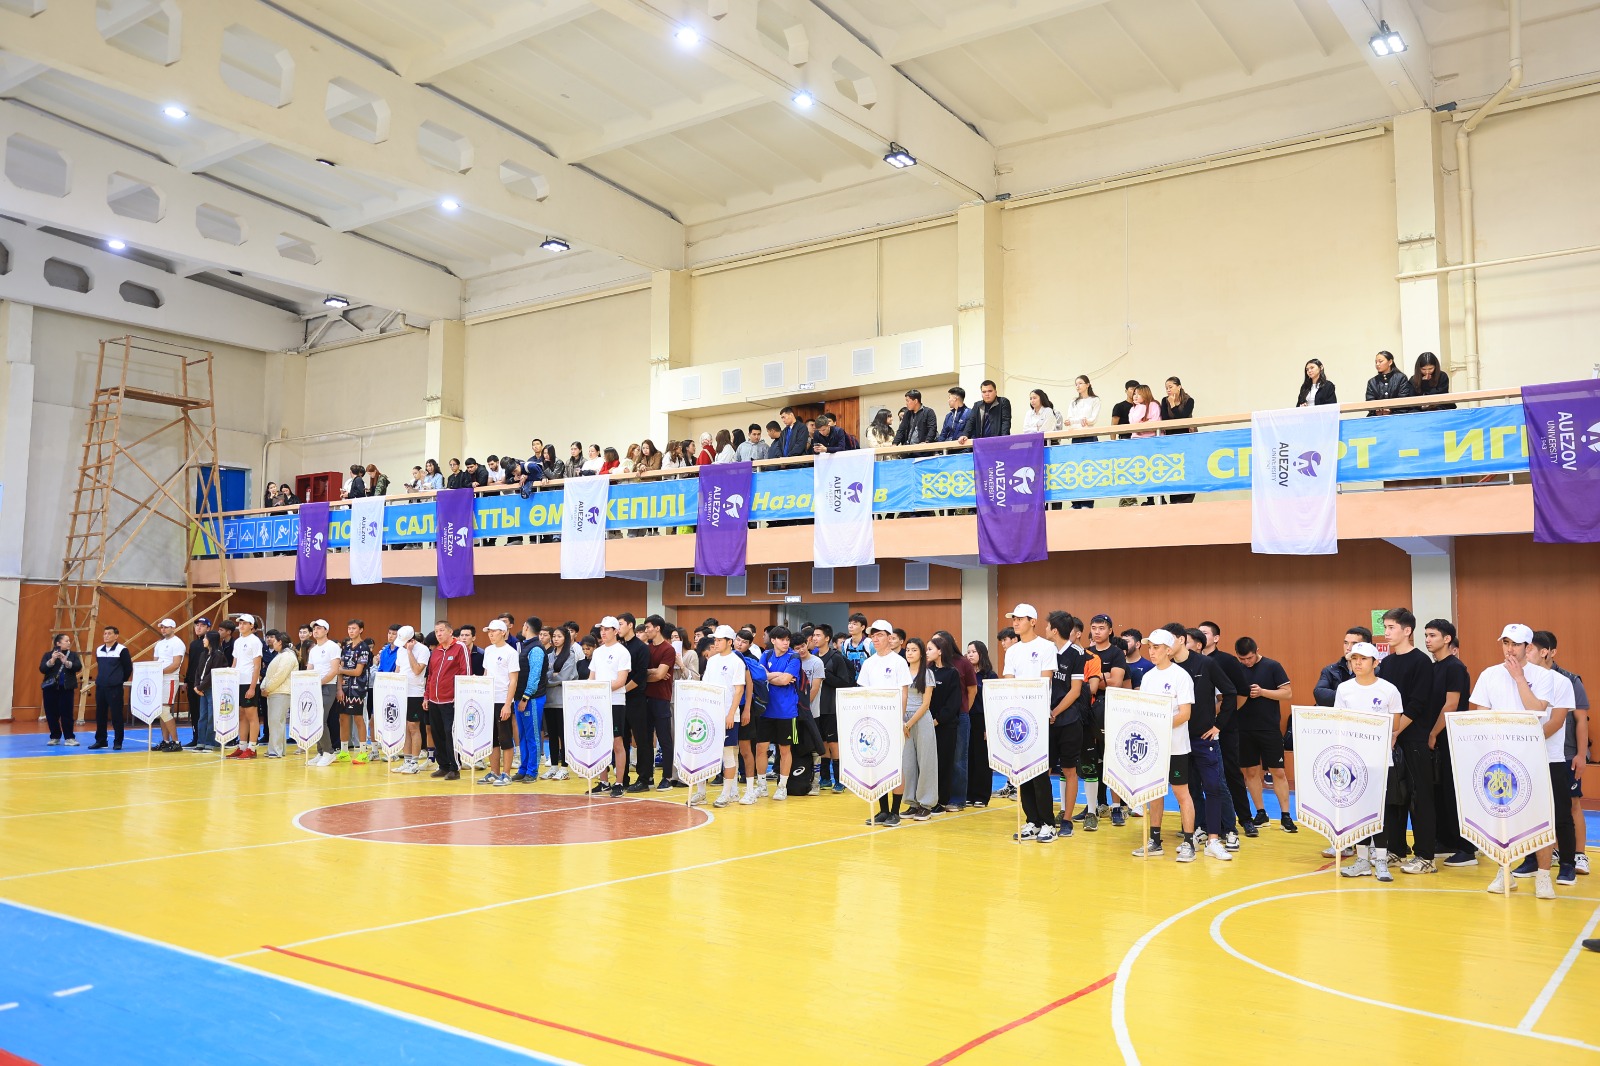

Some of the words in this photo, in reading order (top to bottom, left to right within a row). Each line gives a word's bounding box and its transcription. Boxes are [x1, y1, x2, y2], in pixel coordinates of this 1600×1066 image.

[1546, 420, 1558, 464] UNIVERSITY
[1557, 411, 1577, 471] AUEZOV
[995, 460, 1006, 508] AUEZOV
[1278, 441, 1289, 488] AUEZOV
[529, 503, 564, 527] ӨМ
[606, 493, 686, 521] КЕПІЛІ
[711, 485, 722, 528] AUEZOV
[834, 475, 842, 513] AUEZOV
[1334, 729, 1382, 741] UNIVERSITY
[1457, 734, 1489, 742] AUEZOV
[1491, 734, 1540, 742] UNIVERSITY
